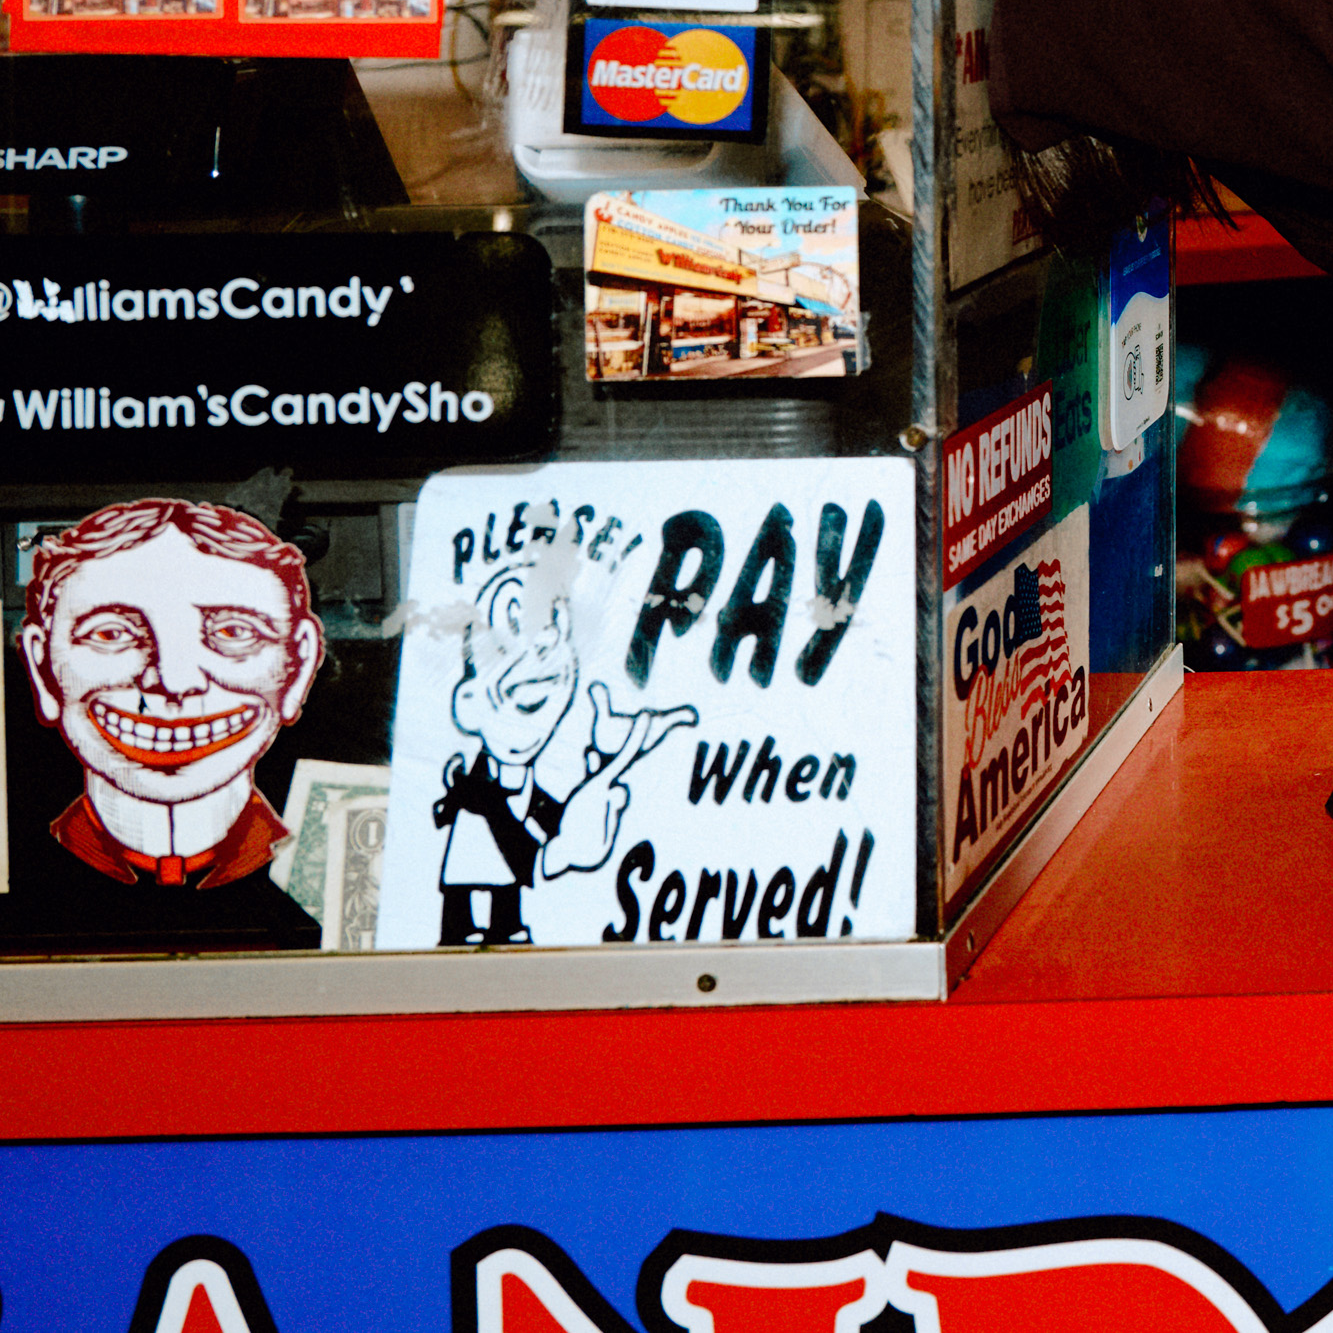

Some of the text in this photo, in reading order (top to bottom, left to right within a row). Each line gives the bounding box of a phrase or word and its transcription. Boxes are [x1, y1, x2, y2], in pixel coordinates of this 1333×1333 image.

[590, 57, 743, 94] MasterCard
[719, 195, 851, 213] Thank You For
[735, 218, 837, 236] Your Order!
[948, 391, 1052, 528] NO REFUNDS
[948, 474, 1051, 573] SAME DAY EXCHANGES
[624, 498, 886, 690] PAY
[954, 591, 1021, 701] God
[963, 649, 1022, 769] Bless
[686, 735, 858, 806] When
[952, 665, 1087, 867] America
[602, 827, 876, 944] Served!
